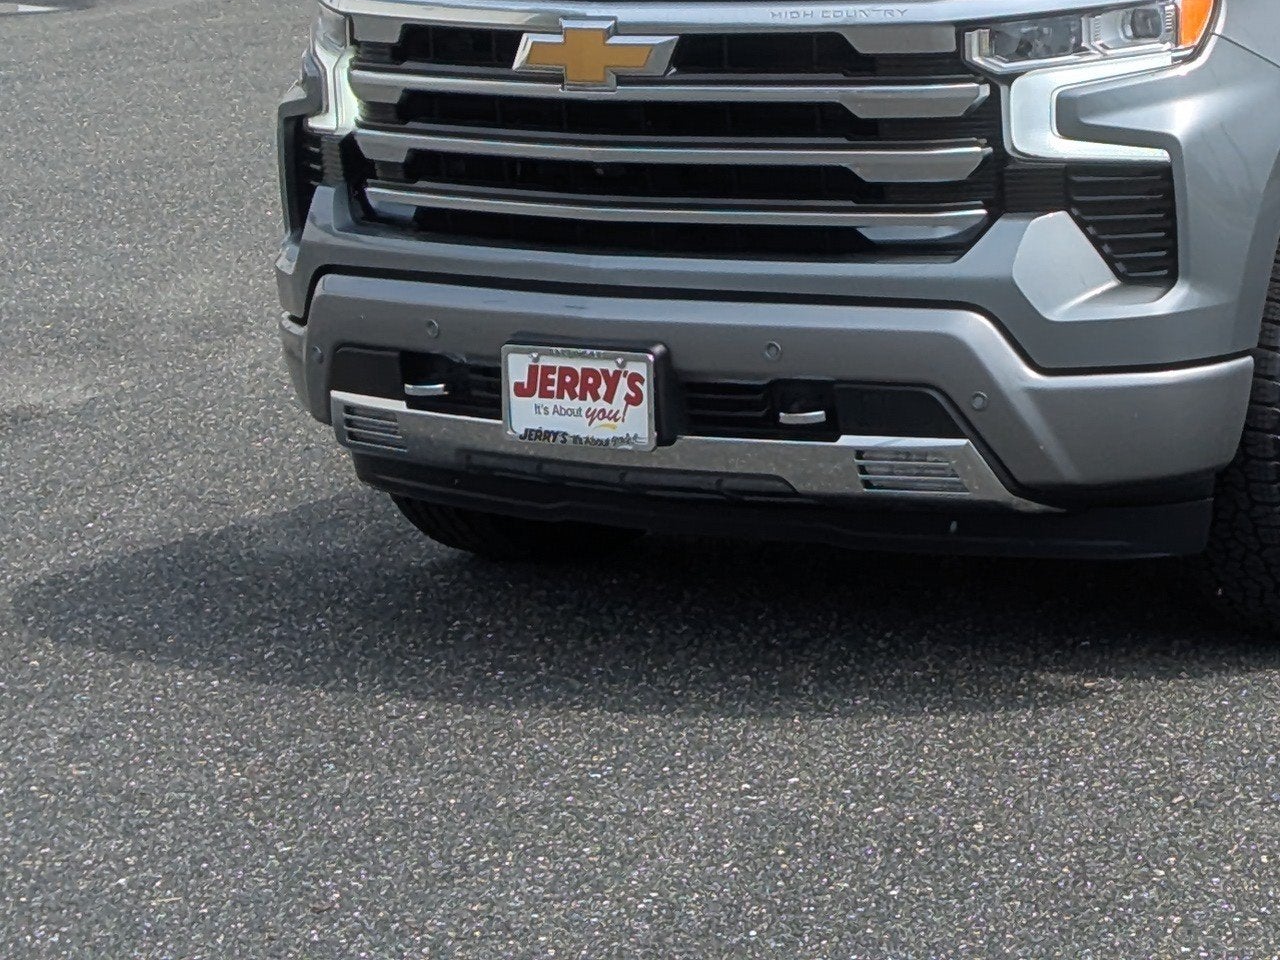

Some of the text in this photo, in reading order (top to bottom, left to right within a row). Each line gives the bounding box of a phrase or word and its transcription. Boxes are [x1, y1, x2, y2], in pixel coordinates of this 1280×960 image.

[820, 7, 908, 19] COUNTRY
[513, 363, 646, 407] JERRY'S
[534, 403, 549, 415] It's
[552, 404, 583, 417] About
[519, 427, 568, 445] JERRY'S
